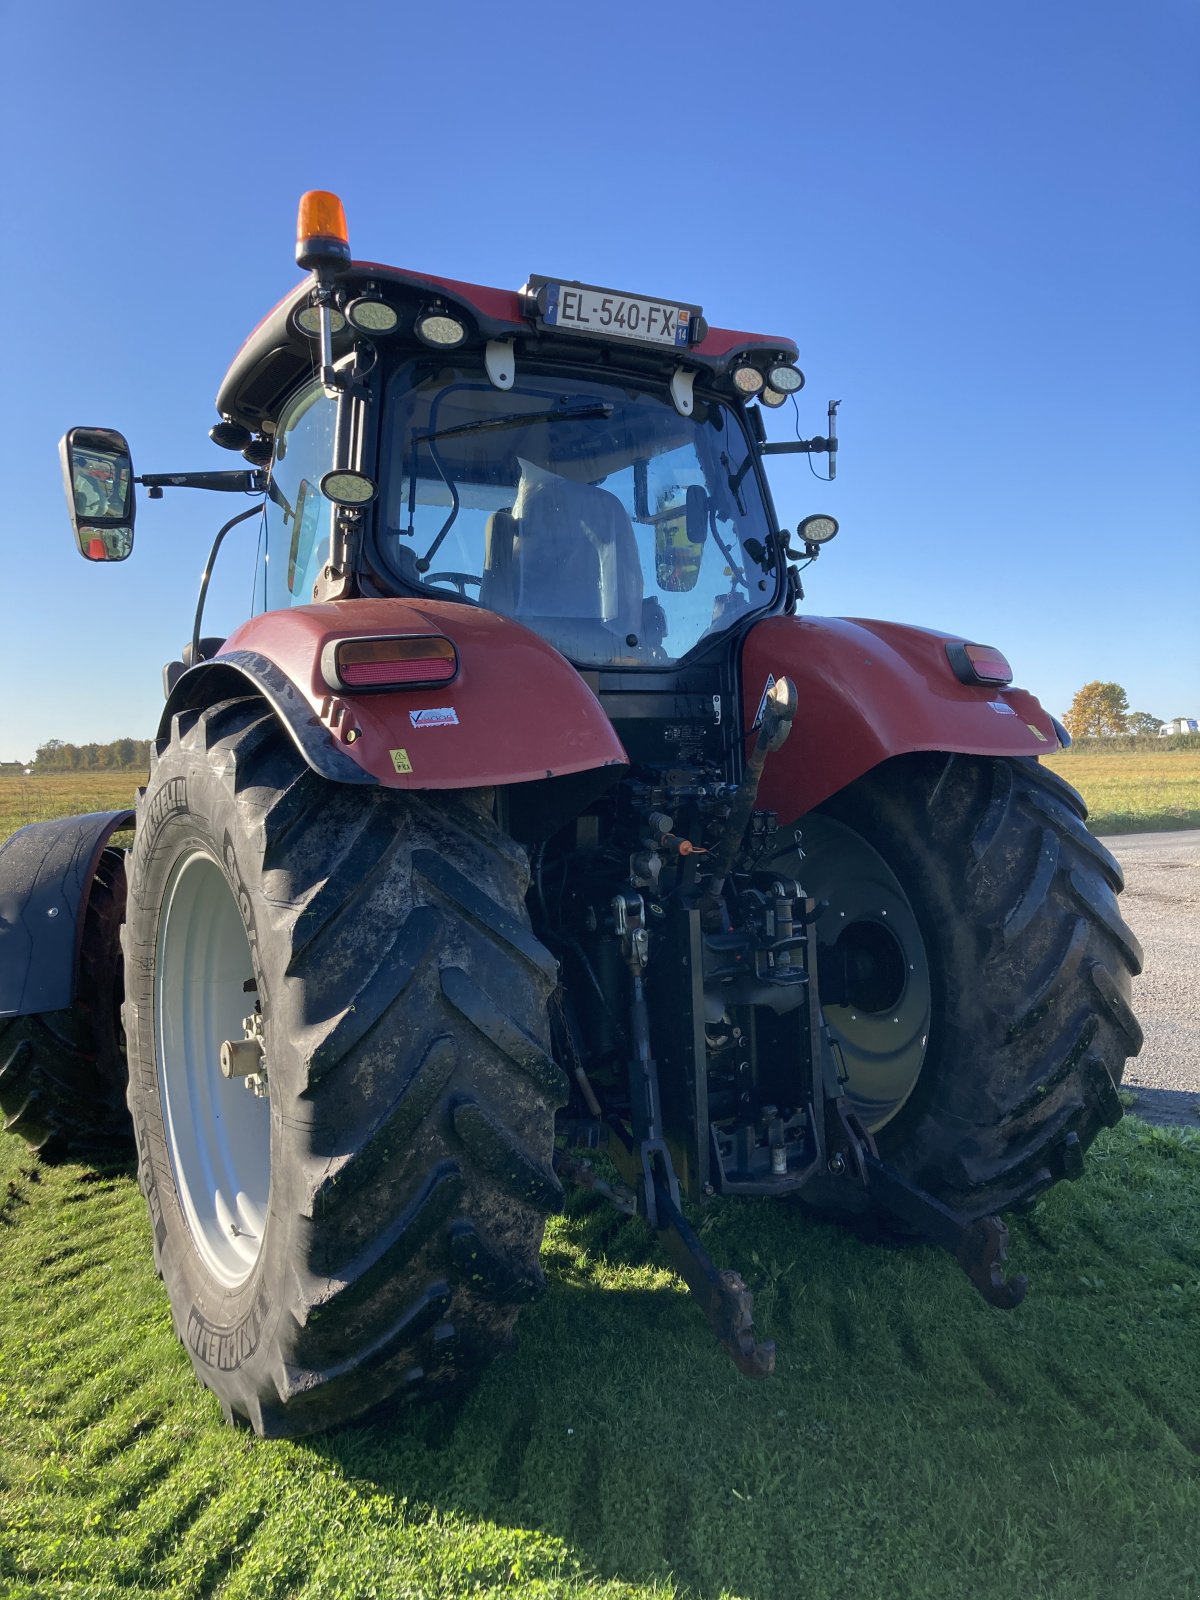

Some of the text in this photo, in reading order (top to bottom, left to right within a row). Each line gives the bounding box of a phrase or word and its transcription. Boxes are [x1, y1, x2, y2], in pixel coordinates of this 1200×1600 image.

[561, 291, 674, 337] EL-540-FX
[678, 329, 687, 341] 14
[137, 778, 188, 870] MICHELIN
[187, 1313, 259, 1369] MICHELIN
